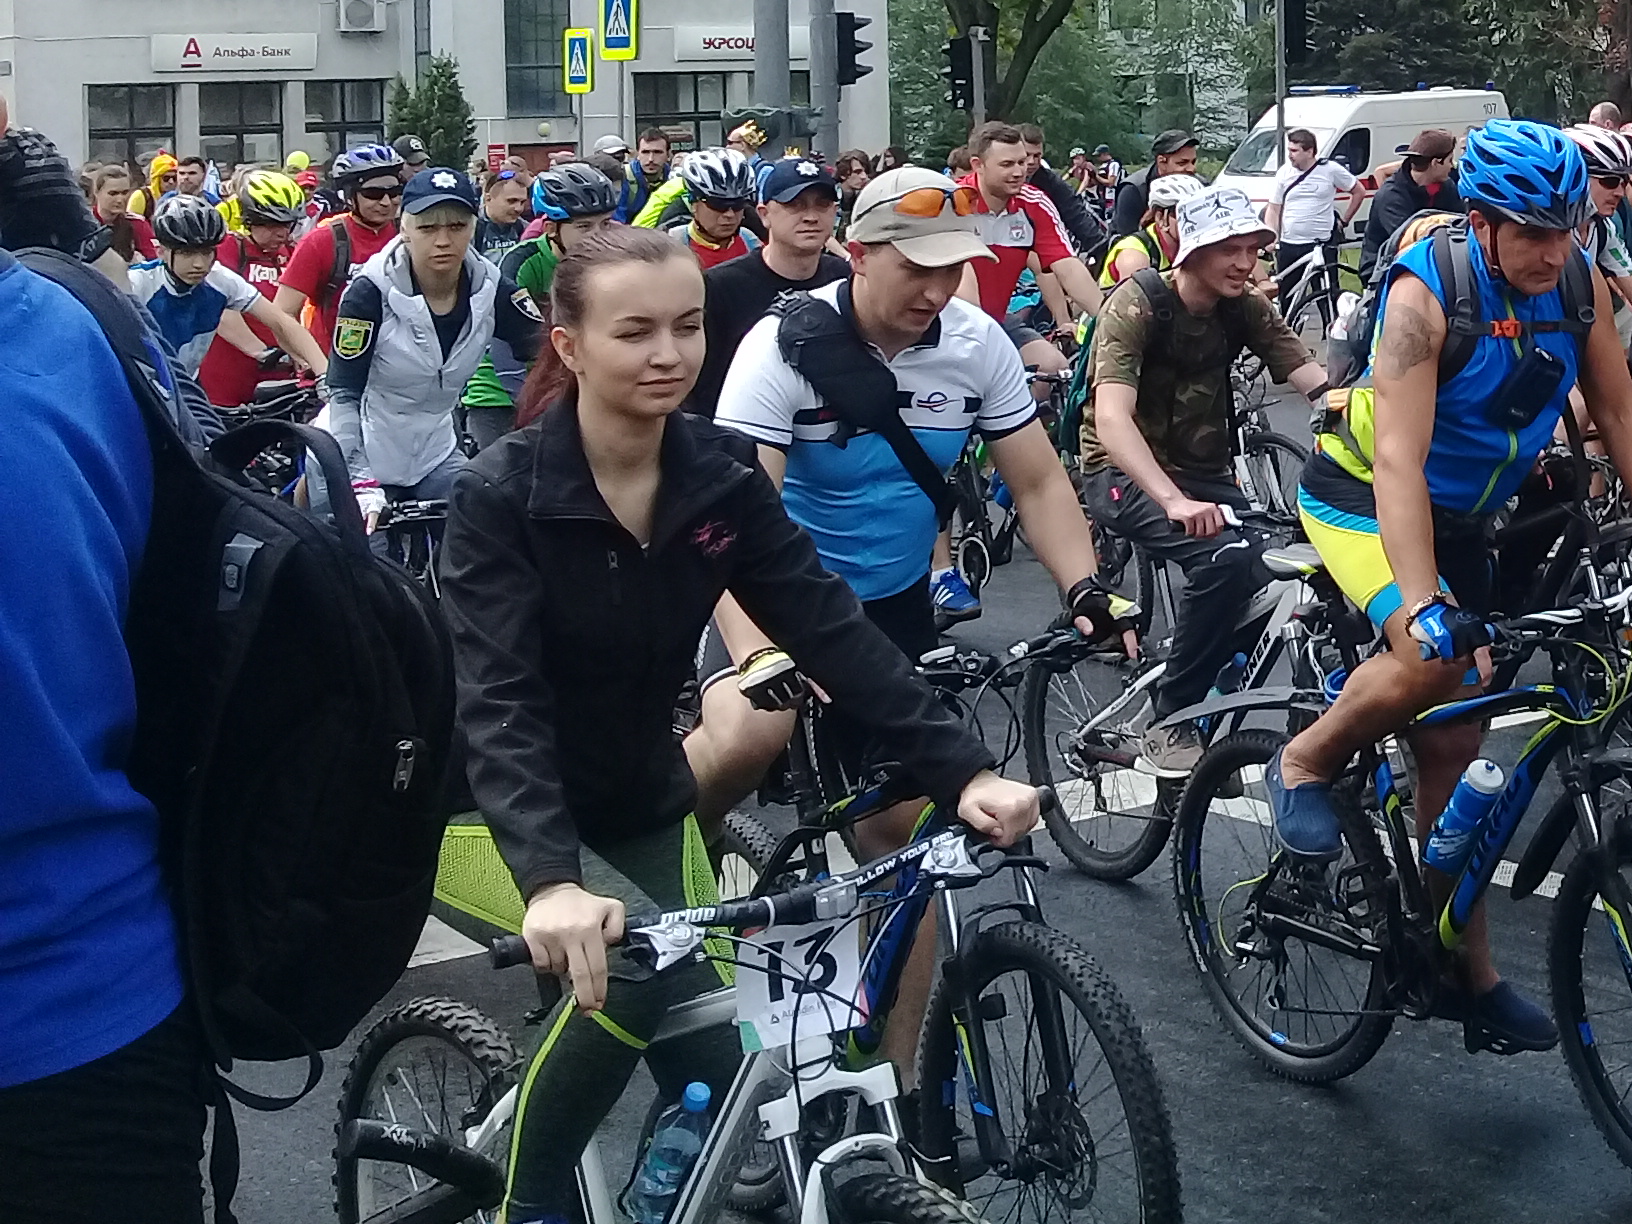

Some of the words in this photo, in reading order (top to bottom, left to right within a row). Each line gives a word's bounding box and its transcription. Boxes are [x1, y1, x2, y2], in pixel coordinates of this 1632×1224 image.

[212, 45, 291, 59] Альфа-Банк
[702, 36, 756, 52] УКРСОЦ
[1482, 102, 1497, 115] 107
[899, 841, 930, 863] YOUR
[757, 925, 838, 1003] 13
